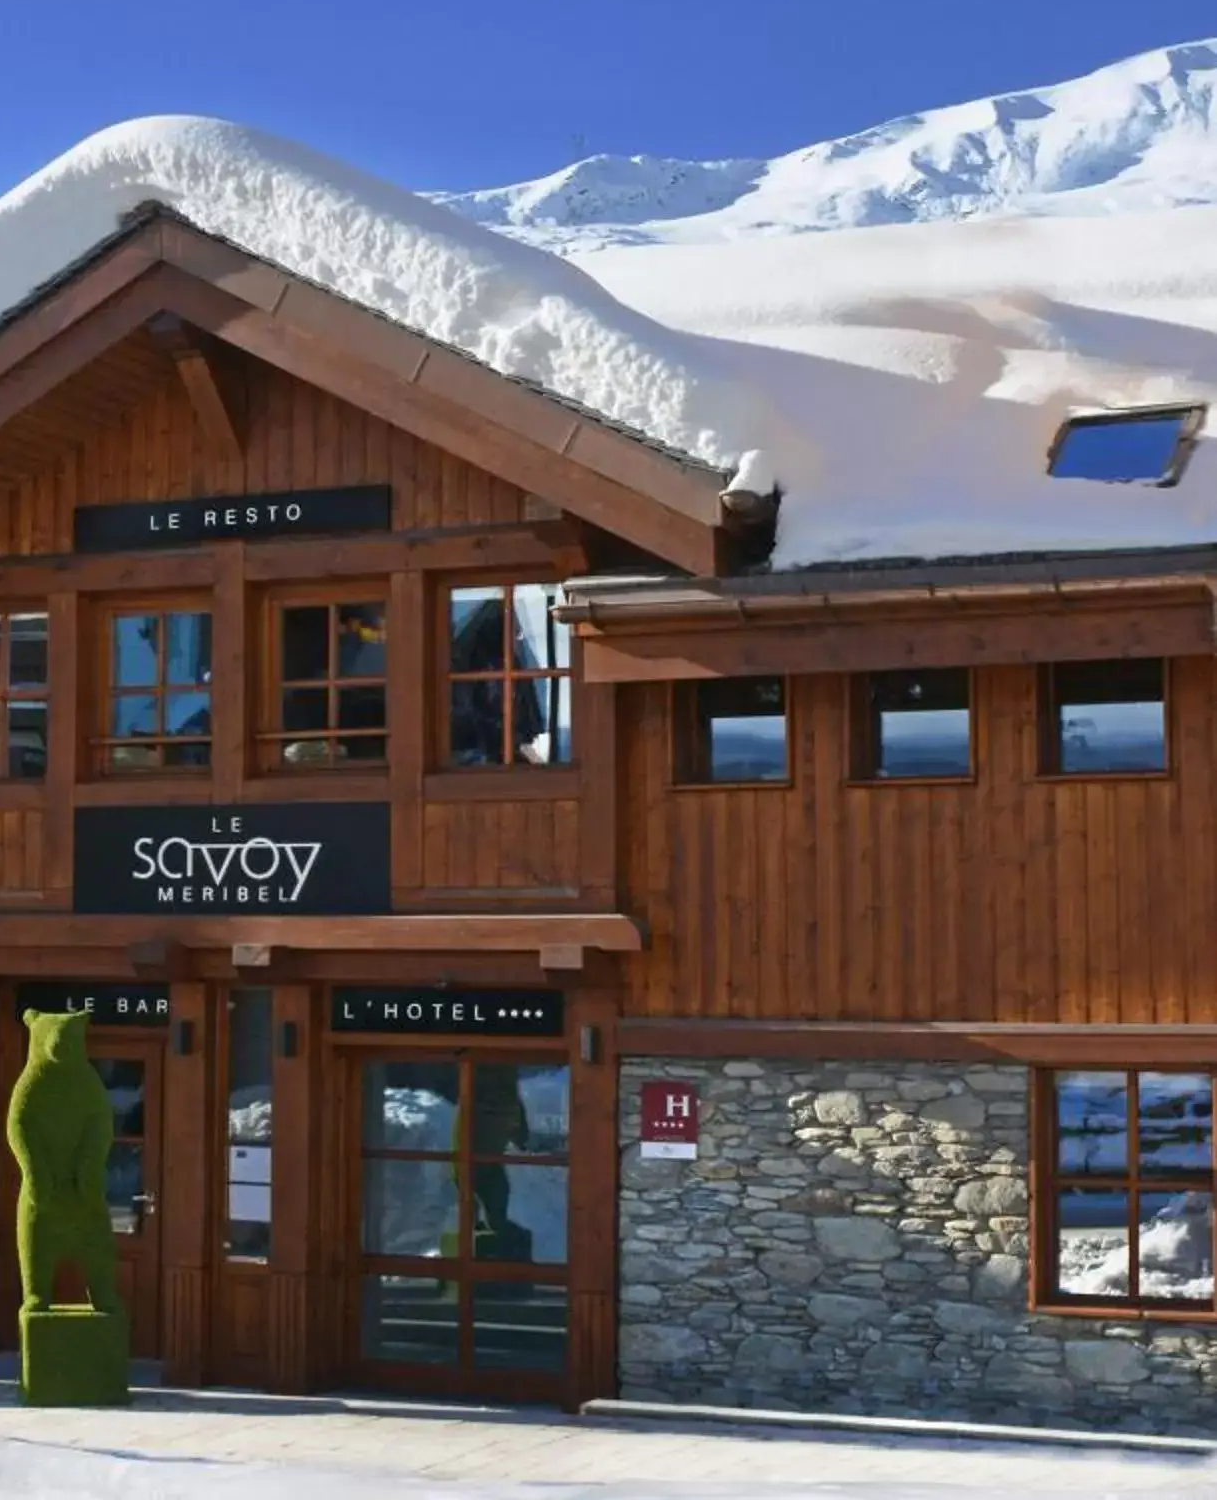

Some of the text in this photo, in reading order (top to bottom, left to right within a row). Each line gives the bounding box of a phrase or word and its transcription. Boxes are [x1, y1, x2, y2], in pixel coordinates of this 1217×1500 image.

[150, 503, 302, 531] LE RESTO
[212, 817, 243, 833] LE
[158, 886, 289, 902] MERIBEL
[67, 996, 168, 1013] LE BAR
[343, 1000, 486, 1021] L'HOTEL
[666, 1094, 690, 1117] H
